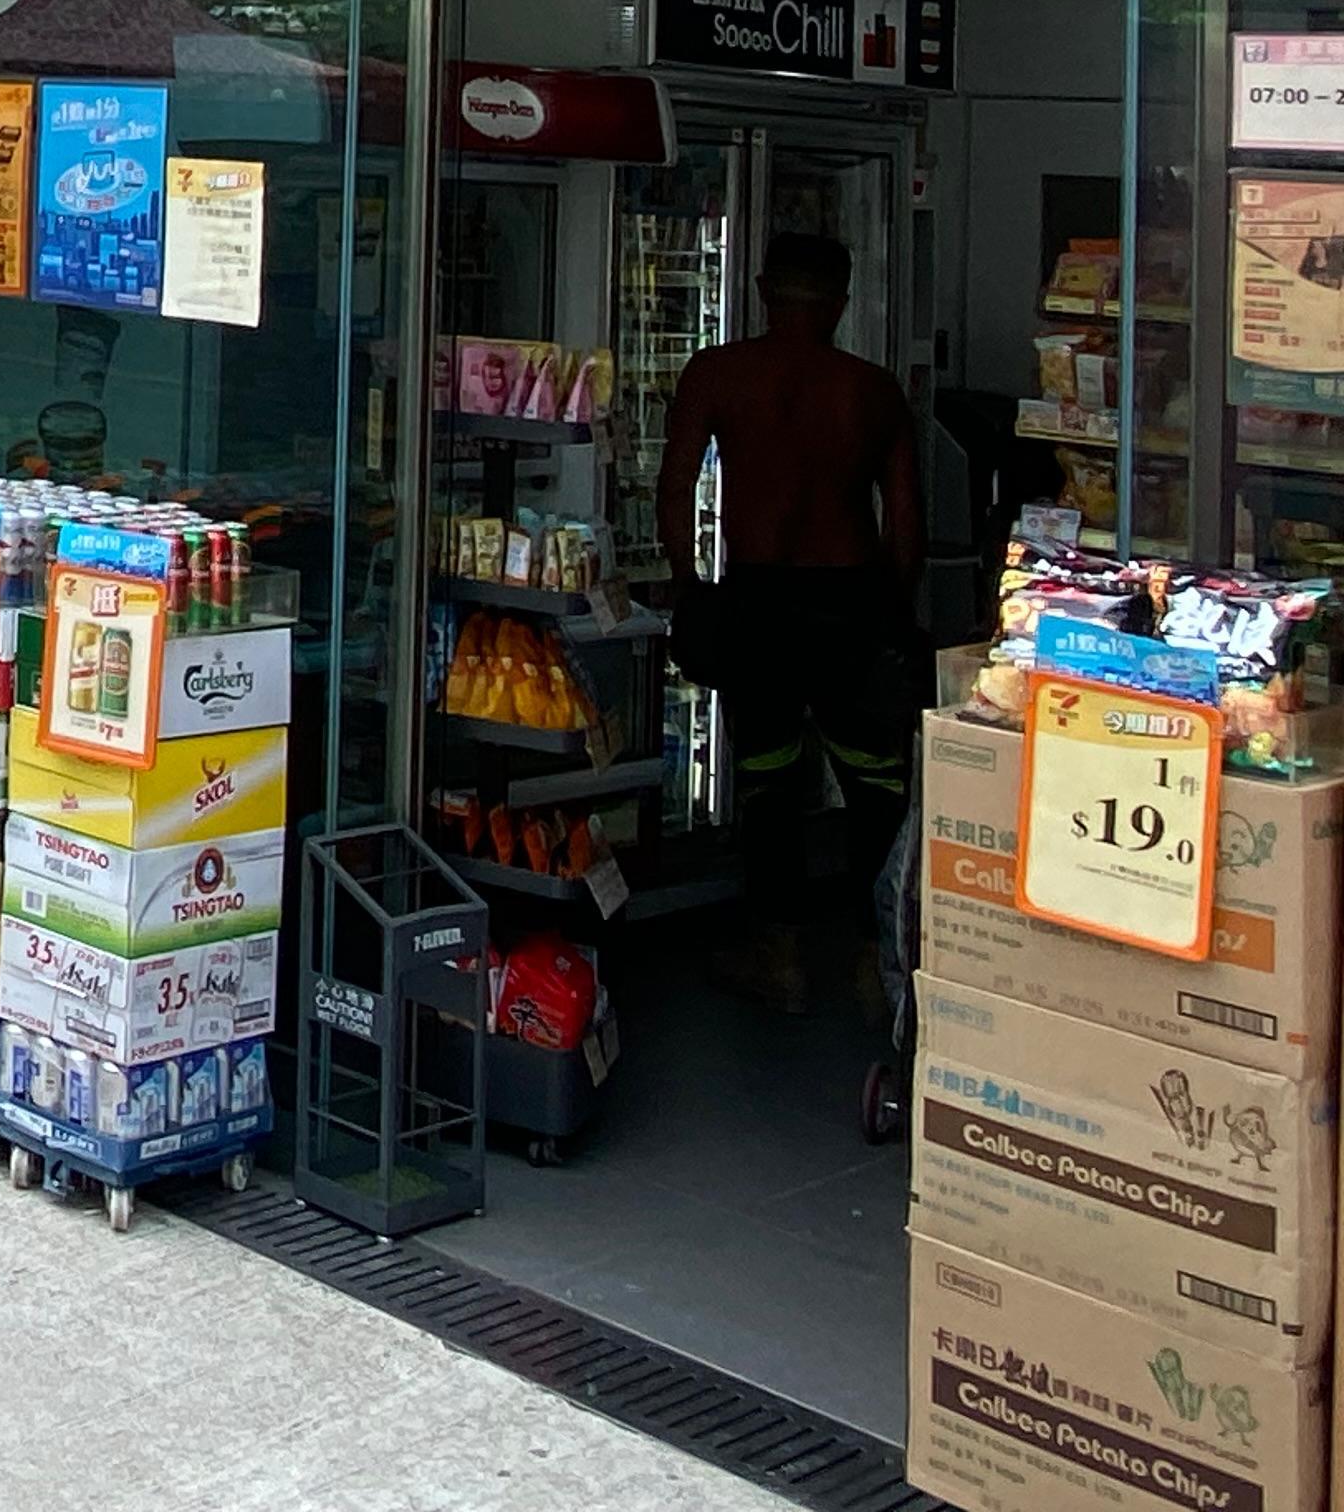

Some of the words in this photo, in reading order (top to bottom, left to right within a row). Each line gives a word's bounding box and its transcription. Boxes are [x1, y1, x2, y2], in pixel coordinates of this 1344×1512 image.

[772, 0, 845, 60] Chill
[1250, 87, 1309, 105] 07:00
[183, 661, 254, 701] Carlsberg
[1049, 688, 1081, 728] 7
[1153, 757, 1172, 789] 1
[195, 775, 236, 813] SKOL
[35, 829, 110, 870] TSINGTAO
[1070, 797, 1195, 866] $19.0
[172, 892, 245, 923] TSINGTAO
[63, 961, 107, 1001] Asahi
[962, 1123, 1054, 1173] Calbee
[1057, 1155, 1144, 1202] Potato
[1146, 1183, 1225, 1226] Chips
[958, 1381, 1053, 1440] Calbee
[1056, 1423, 1148, 1478] Potato
[1151, 1458, 1231, 1509] Chips
